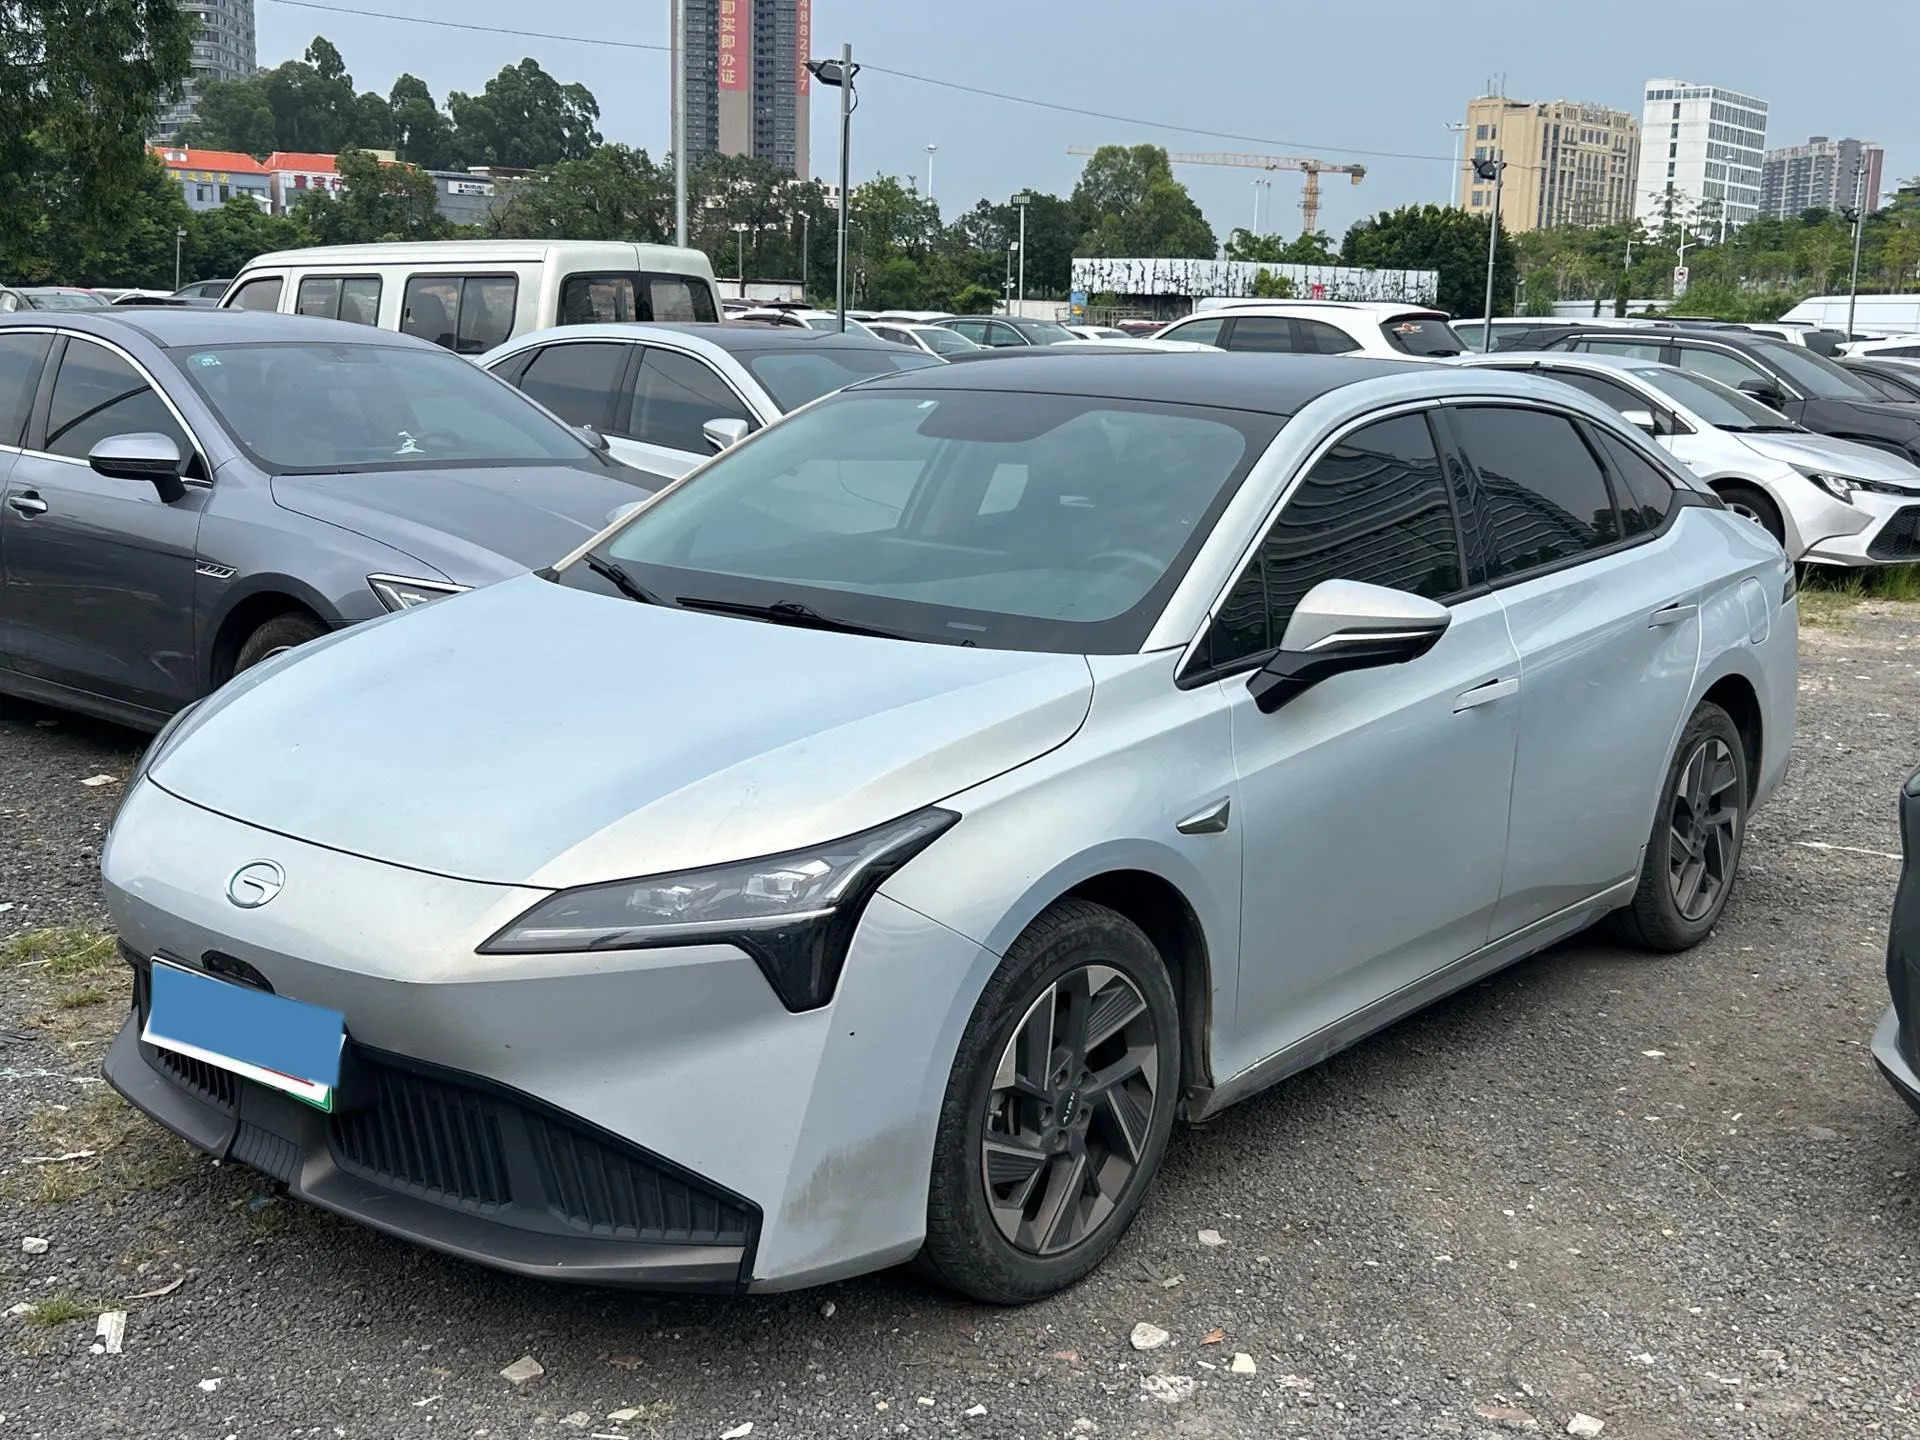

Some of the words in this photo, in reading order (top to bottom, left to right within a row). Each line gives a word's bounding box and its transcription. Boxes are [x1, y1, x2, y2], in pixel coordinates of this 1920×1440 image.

[721, 0, 736, 84] 即买即办证
